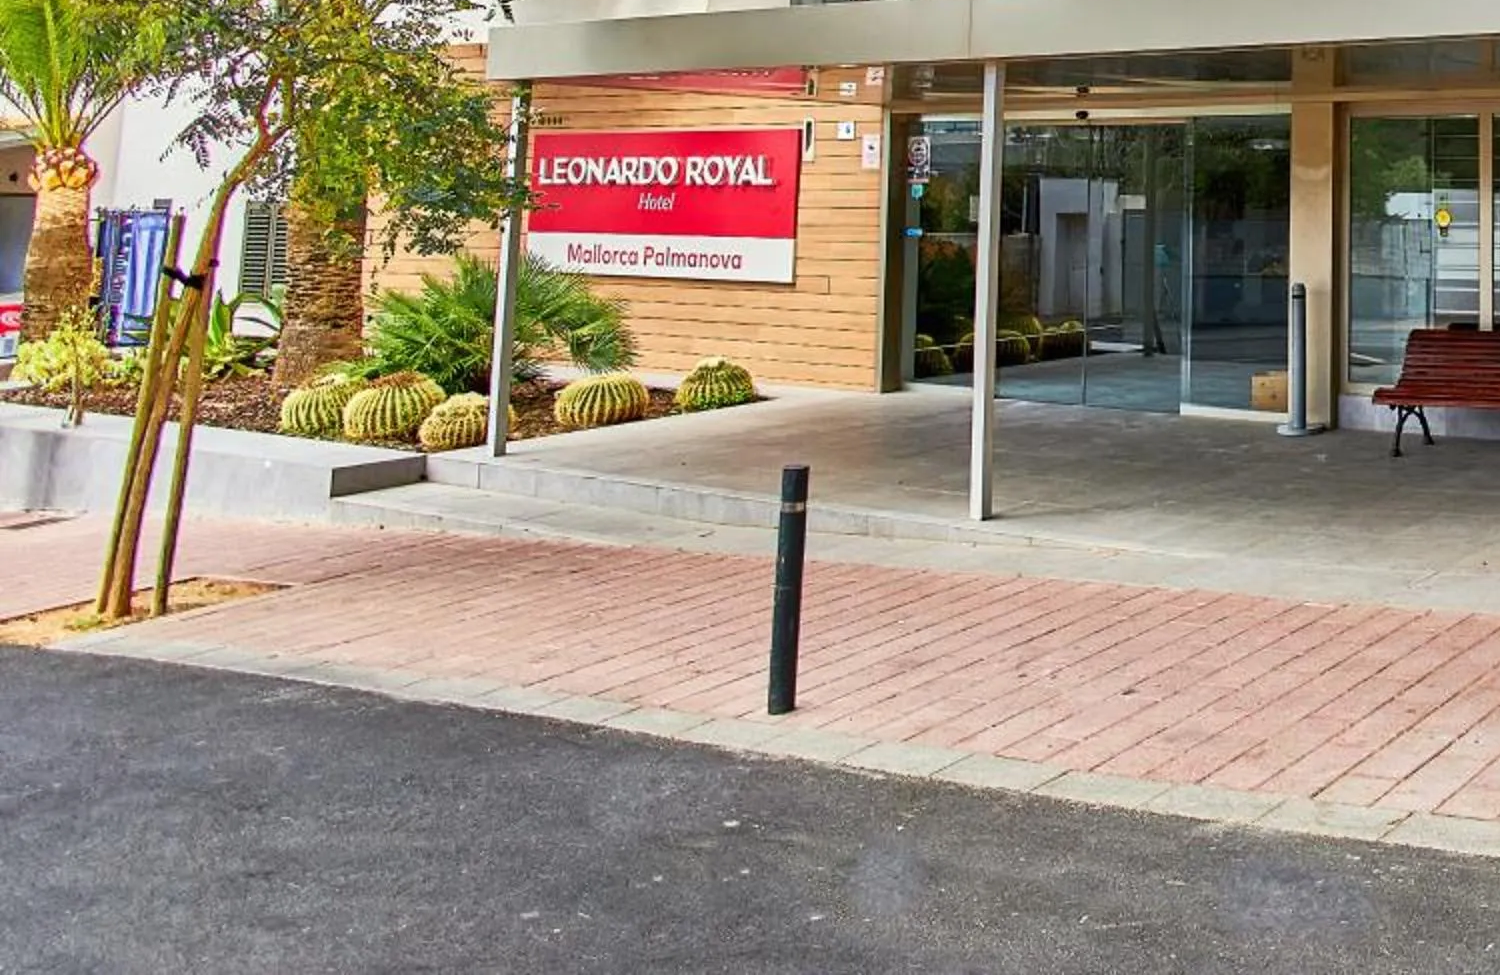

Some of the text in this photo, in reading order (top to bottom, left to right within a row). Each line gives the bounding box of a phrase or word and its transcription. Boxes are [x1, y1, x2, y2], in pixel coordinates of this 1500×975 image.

[538, 154, 774, 186] LEONARDO ROYAL
[637, 192, 677, 211] Hotel
[566, 243, 743, 270] Mallorca Palmanova
